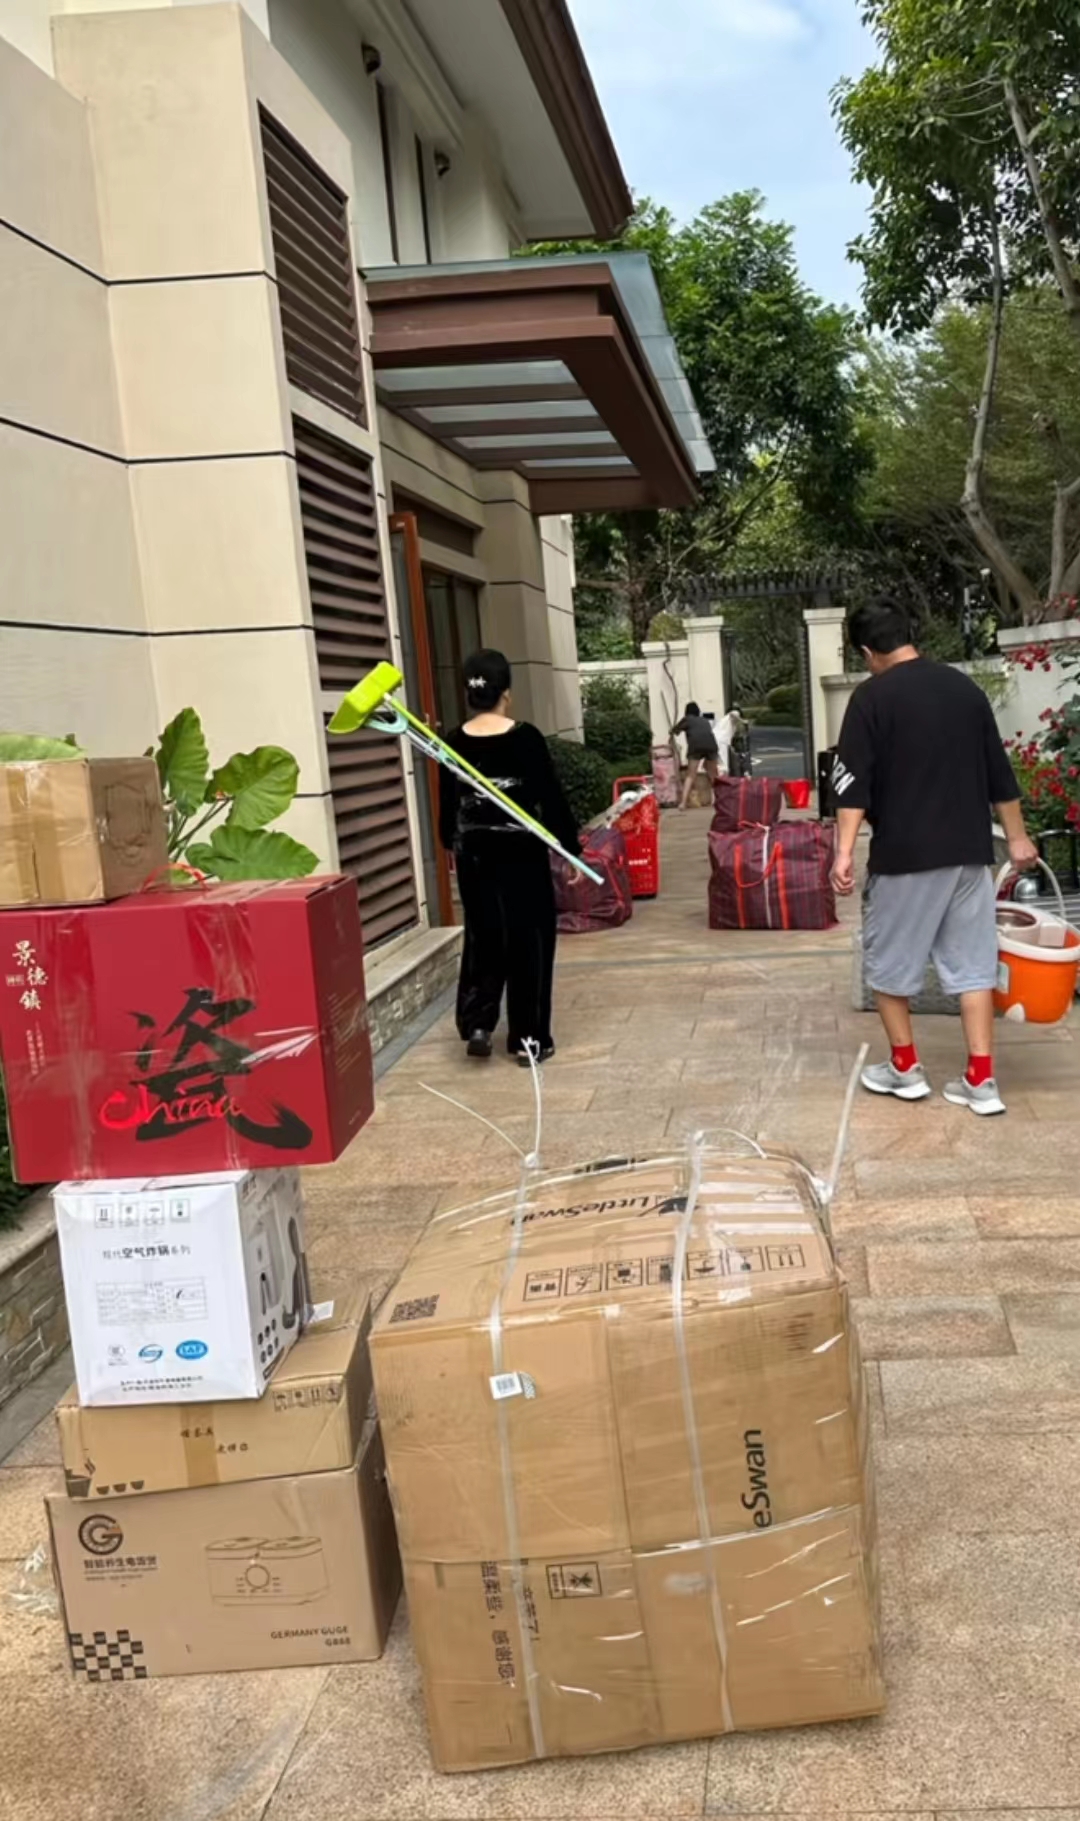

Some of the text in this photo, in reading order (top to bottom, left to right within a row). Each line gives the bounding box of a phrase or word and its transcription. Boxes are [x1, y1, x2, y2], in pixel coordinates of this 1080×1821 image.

[100, 1084, 243, 1129] China
[129, 986, 313, 1150] 瓷
[741, 1428, 772, 1528] eSwan
